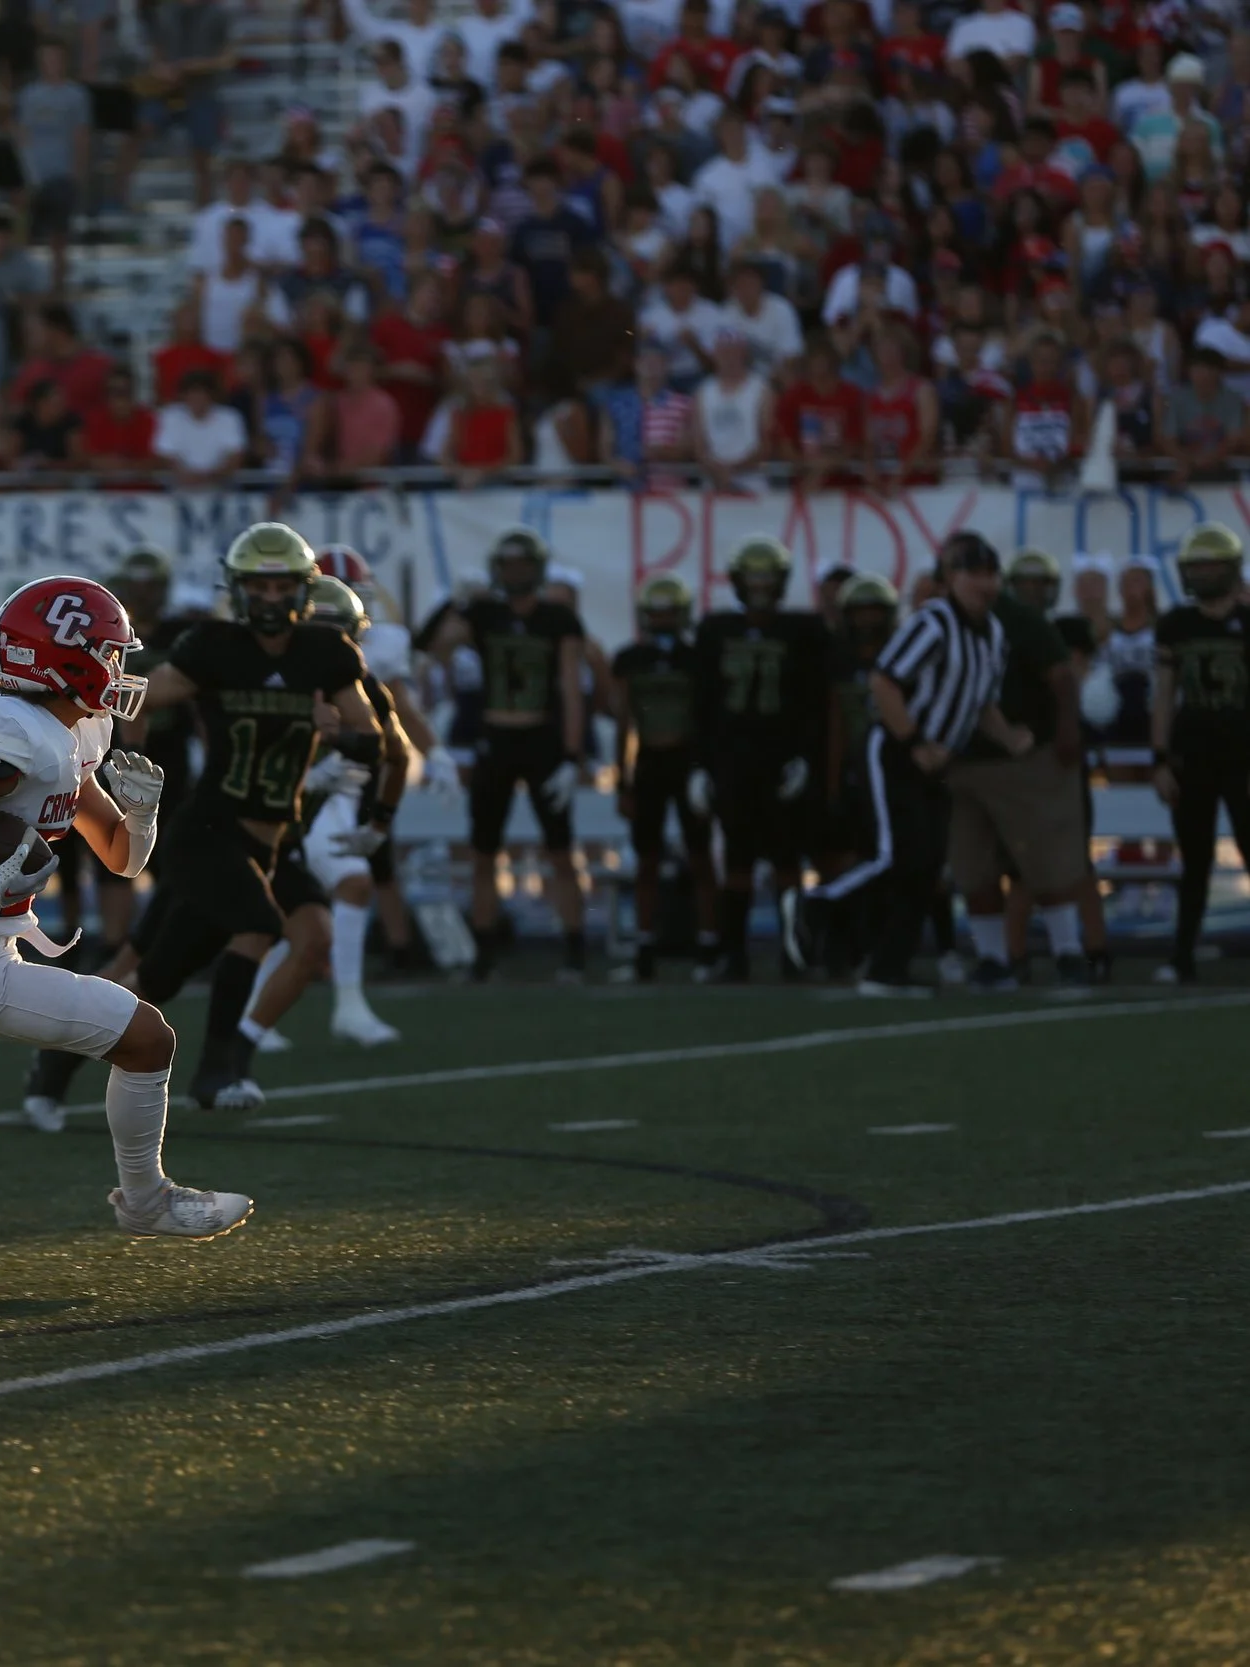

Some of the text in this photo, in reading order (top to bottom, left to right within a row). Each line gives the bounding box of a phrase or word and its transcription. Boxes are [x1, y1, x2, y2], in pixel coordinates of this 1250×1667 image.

[630, 488, 977, 622] READY
[1015, 486, 1206, 606] FOR
[45, 593, 92, 647] CC
[220, 716, 313, 808] 14
